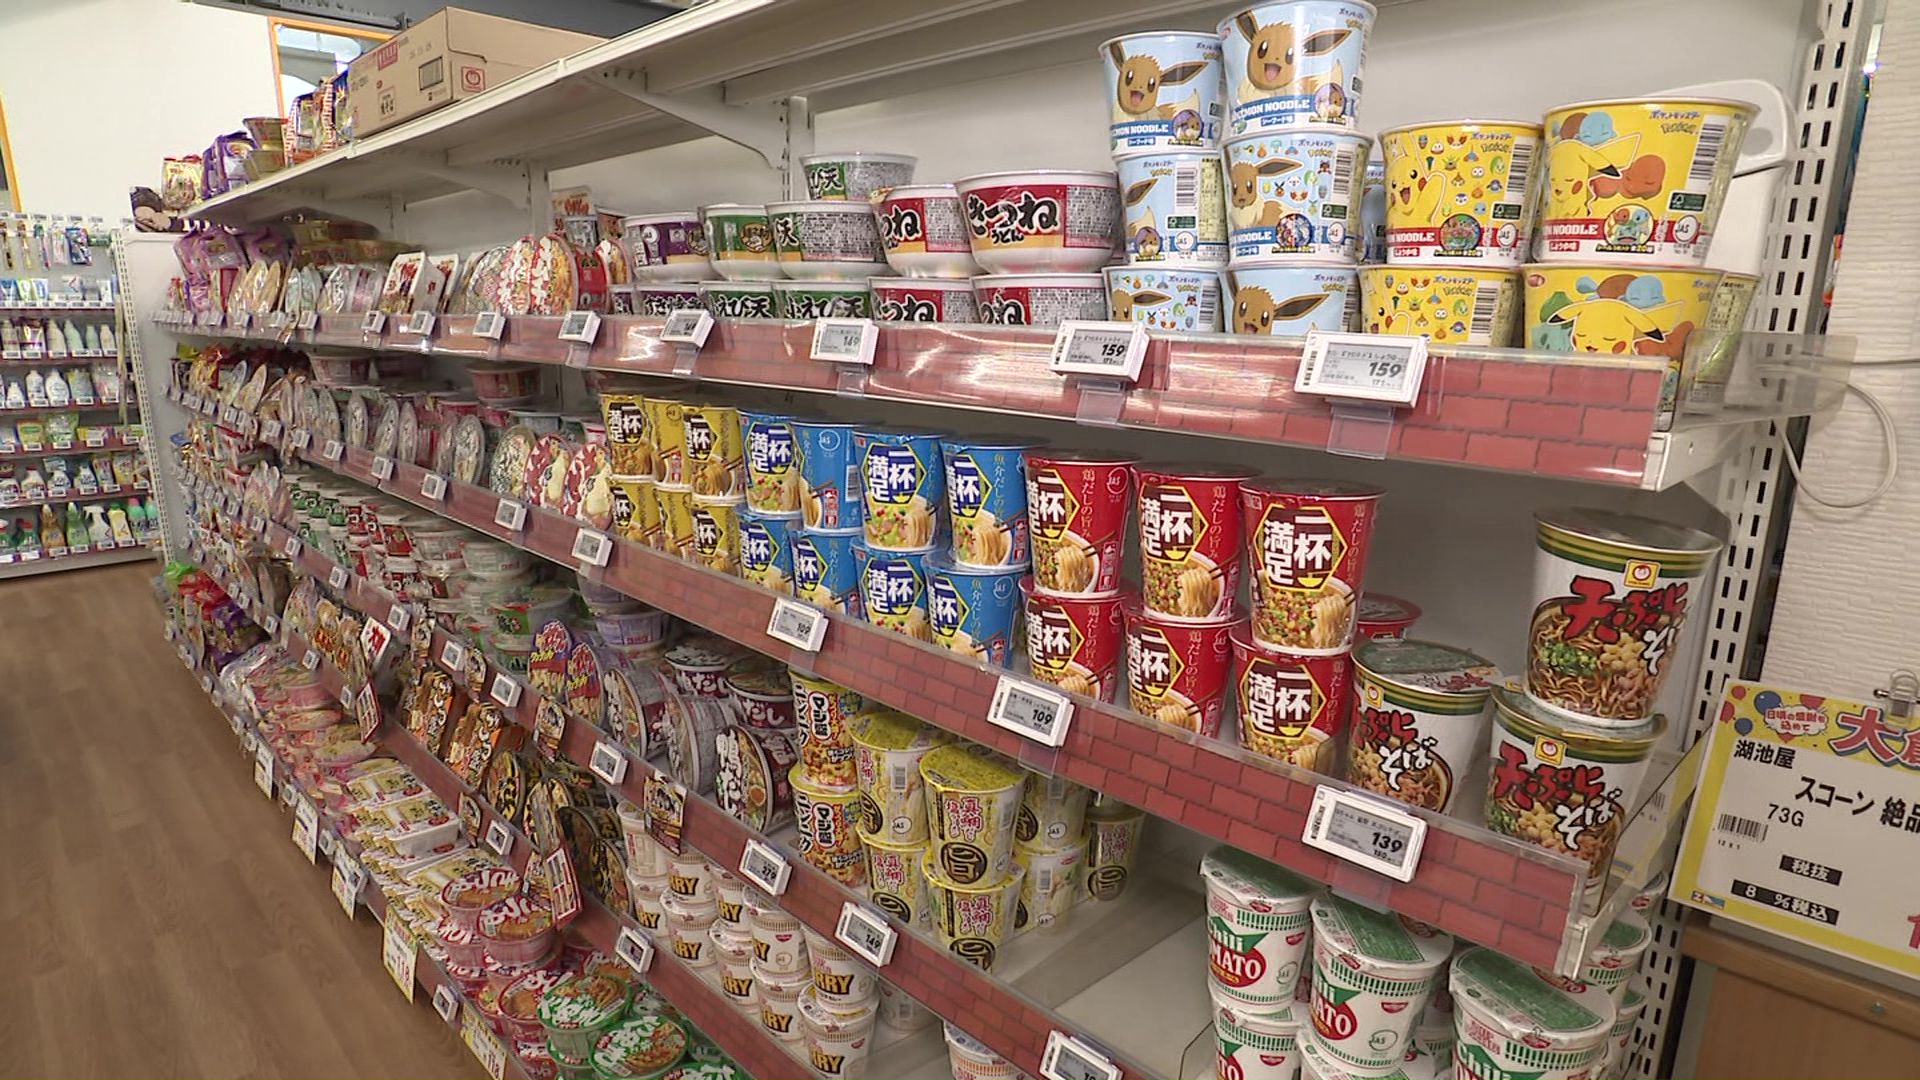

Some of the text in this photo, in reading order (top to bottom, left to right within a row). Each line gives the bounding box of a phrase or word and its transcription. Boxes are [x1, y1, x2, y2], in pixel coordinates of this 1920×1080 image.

[1265, 98, 1310, 113] NOODLE
[1130, 124, 1169, 134] NOODLE
[967, 192, 1059, 237] きつね
[1552, 224, 1599, 236] NOODLE
[990, 227, 1024, 245] うどん
[1396, 232, 1435, 243] NOODLE
[1101, 344, 1125, 357] 159
[1369, 361, 1403, 378] 159
[622, 406, 641, 434] 二杯
[750, 432, 769, 473] 満足
[768, 428, 792, 464] 二杯
[868, 454, 889, 502] 満足
[888, 450, 916, 490] 二杯
[955, 459, 981, 504] 二杯
[1037, 475, 1066, 523] 二杯
[1159, 492, 1194, 544] 二杯
[751, 526, 770, 562] 二杯
[1141, 498, 1162, 557] 満足
[1294, 513, 1333, 571] 二杯
[1263, 519, 1294, 586] 満足
[868, 568, 889, 613] 満足
[888, 566, 914, 601] 二杯
[934, 579, 960, 623] 二杯
[1041, 610, 1072, 654] 二杯
[1141, 633, 1170, 680] 二杯
[743, 698, 786, 727] だし
[1032, 708, 1053, 724] 109
[1248, 672, 1276, 732] 満足
[1275, 671, 1311, 721] 二杯
[1378, 736, 1439, 792] そば
[1733, 739, 1797, 770] 湖池屋
[1555, 788, 1623, 851] そば
[1766, 803, 1805, 828] 73G
[1794, 775, 1920, 834] スコーン 絶品
[1372, 832, 1403, 853] 139
[1790, 858, 1831, 882] 税抜
[1745, 885, 1757, 898] 8
[1773, 894, 1829, 922] %税込
